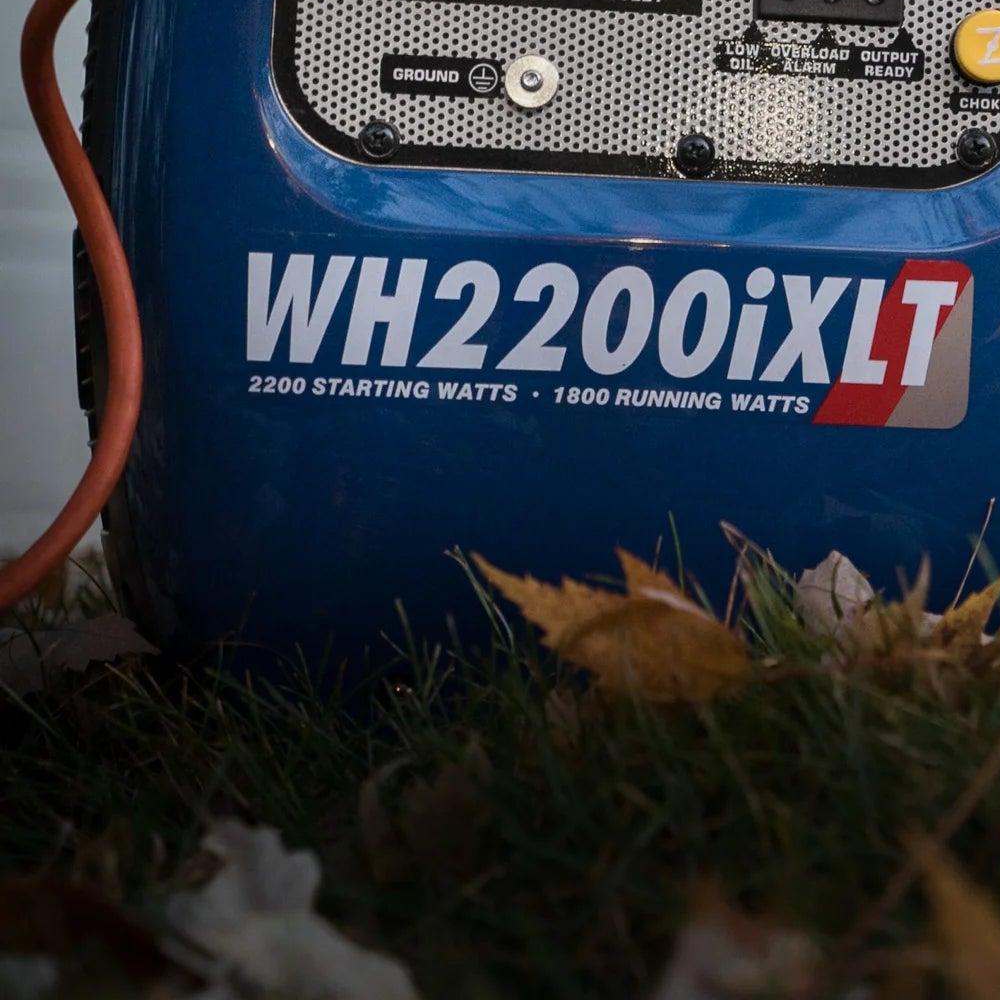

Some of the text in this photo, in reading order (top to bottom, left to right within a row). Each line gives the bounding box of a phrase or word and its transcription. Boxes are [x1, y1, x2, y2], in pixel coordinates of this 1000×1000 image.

[725, 42, 760, 57] LOW
[771, 45, 850, 61] OVERLOAD
[861, 50, 919, 64] OUTPUT
[730, 58, 755, 70] OIL
[783, 60, 836, 74] ALARM
[864, 65, 914, 78] READY
[393, 67, 460, 84] GROUND
[246, 252, 959, 387] WH2200iXLT
[248, 374, 811, 415] 2200 STARTING WATTS 1800 RUNNING WATTS
